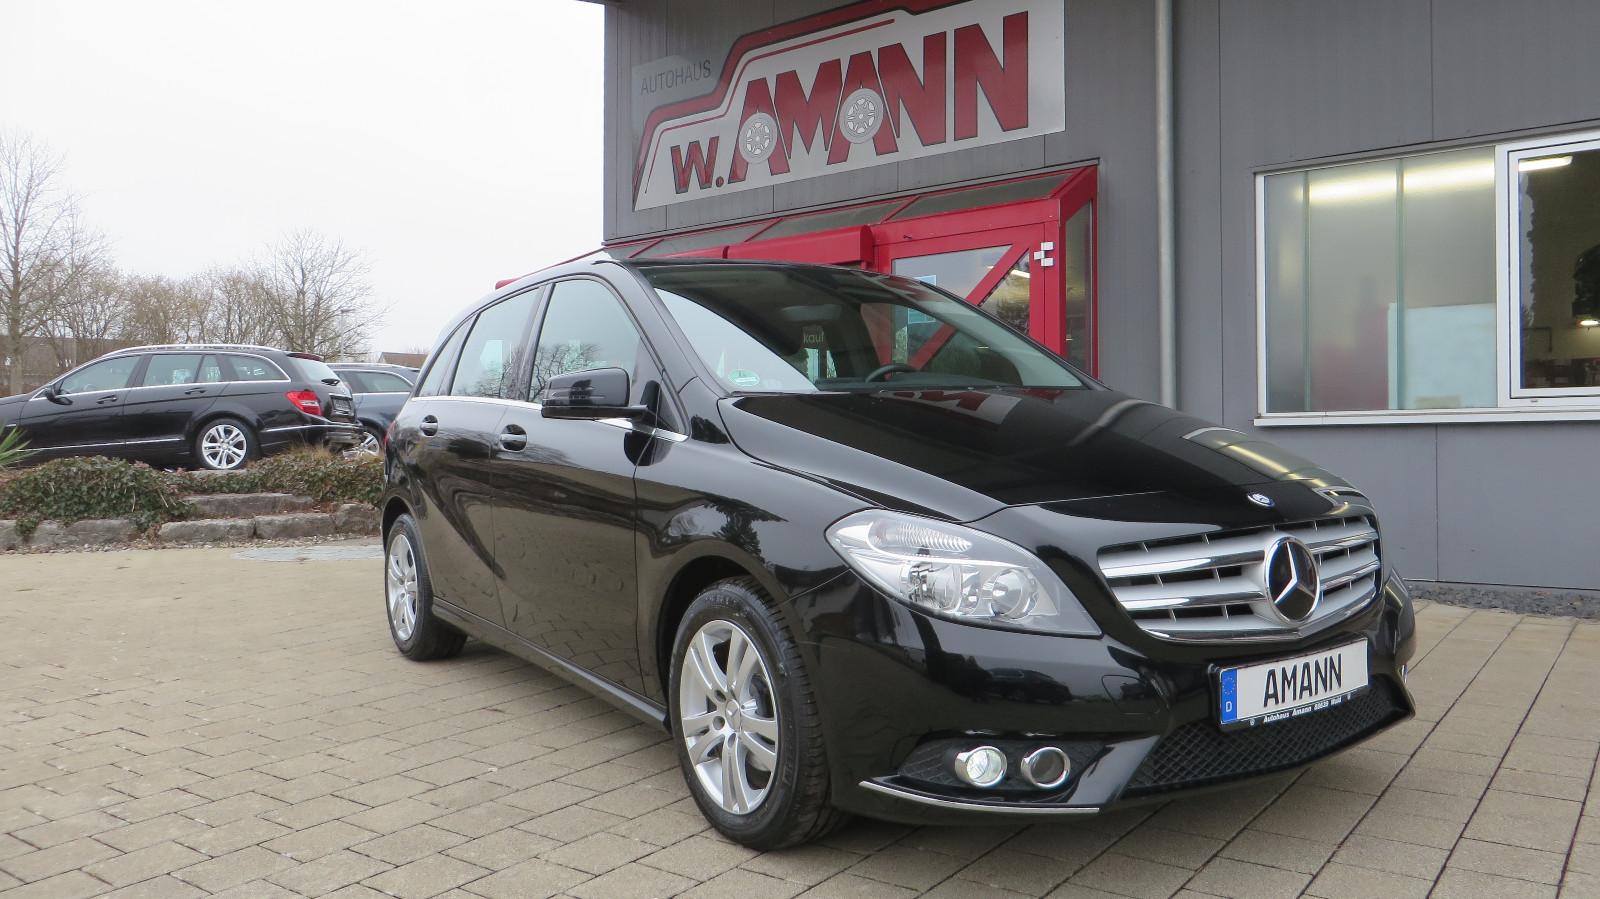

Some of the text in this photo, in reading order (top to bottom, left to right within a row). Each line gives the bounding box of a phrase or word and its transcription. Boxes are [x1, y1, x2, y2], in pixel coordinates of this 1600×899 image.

[640, 59, 712, 96] AUTOHAUS
[727, 10, 1029, 185] AMANN
[1263, 653, 1342, 708] AMANN
[1225, 701, 1233, 713] D
[1263, 710, 1290, 724] Autohaus
[1291, 706, 1312, 717] Amann
